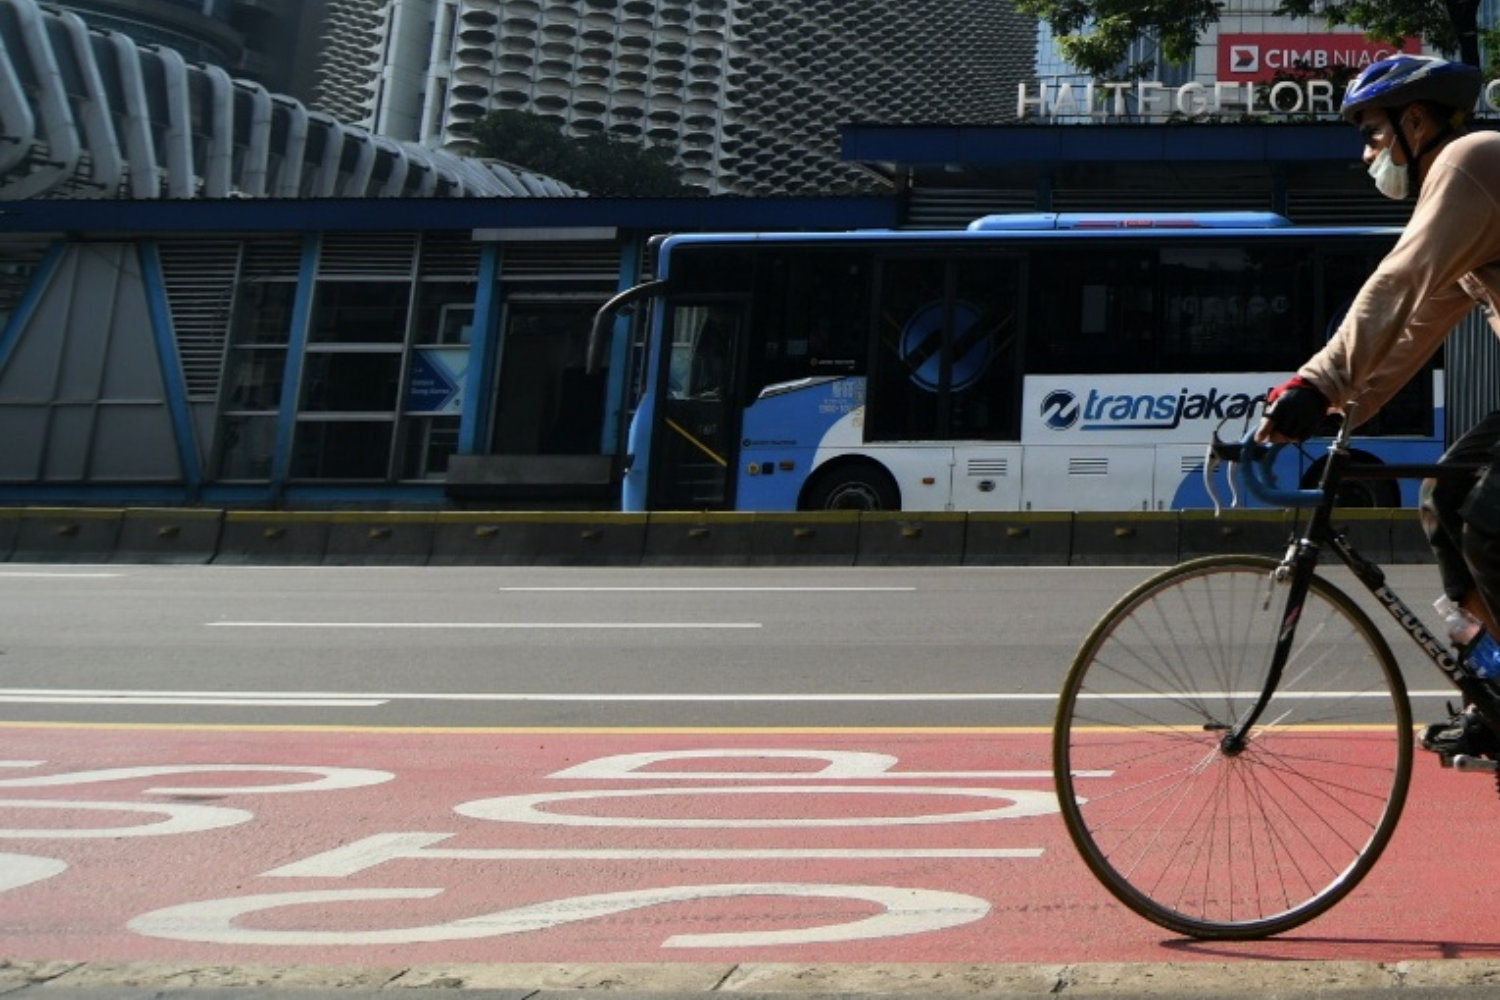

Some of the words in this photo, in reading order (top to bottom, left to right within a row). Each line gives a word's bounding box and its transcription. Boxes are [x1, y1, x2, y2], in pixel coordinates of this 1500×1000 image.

[1265, 50, 1328, 68] CIMB
[1334, 49, 1403, 68] NIA
[1017, 81, 1163, 118] HALTE
[1177, 80, 1354, 115] GELOR
[1081, 387, 1274, 430] transjakar
